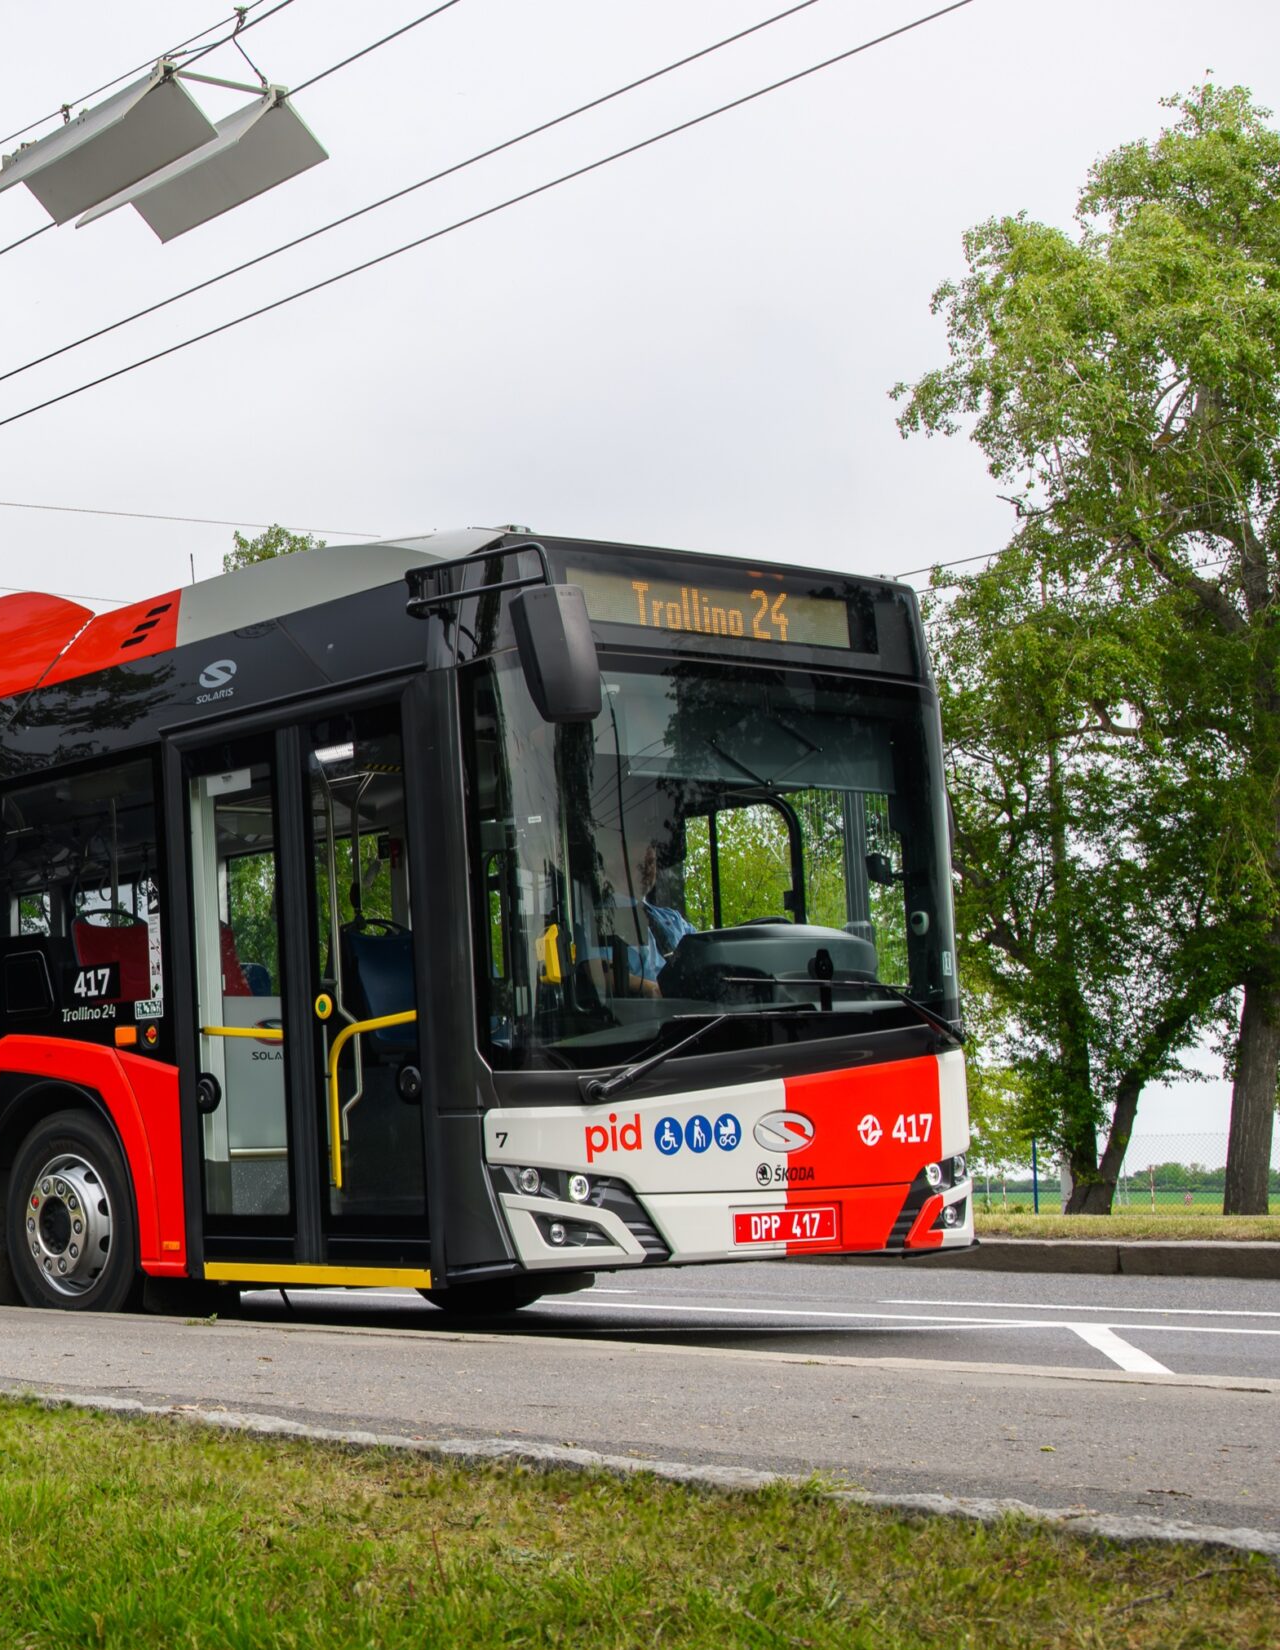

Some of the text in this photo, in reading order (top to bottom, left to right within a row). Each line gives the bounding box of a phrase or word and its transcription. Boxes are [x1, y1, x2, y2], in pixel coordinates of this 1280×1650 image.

[631, 581, 789, 641] Trollino 24
[195, 687, 234, 704] SOLARIS
[73, 968, 110, 998] 417
[61, 1003, 116, 1022] Trollino 24
[495, 1132, 509, 1148] 7
[585, 1112, 642, 1163] pid
[892, 1113, 933, 1143] 417
[774, 1165, 815, 1182] ŠKODA
[750, 1213, 820, 1240] DPP 417
